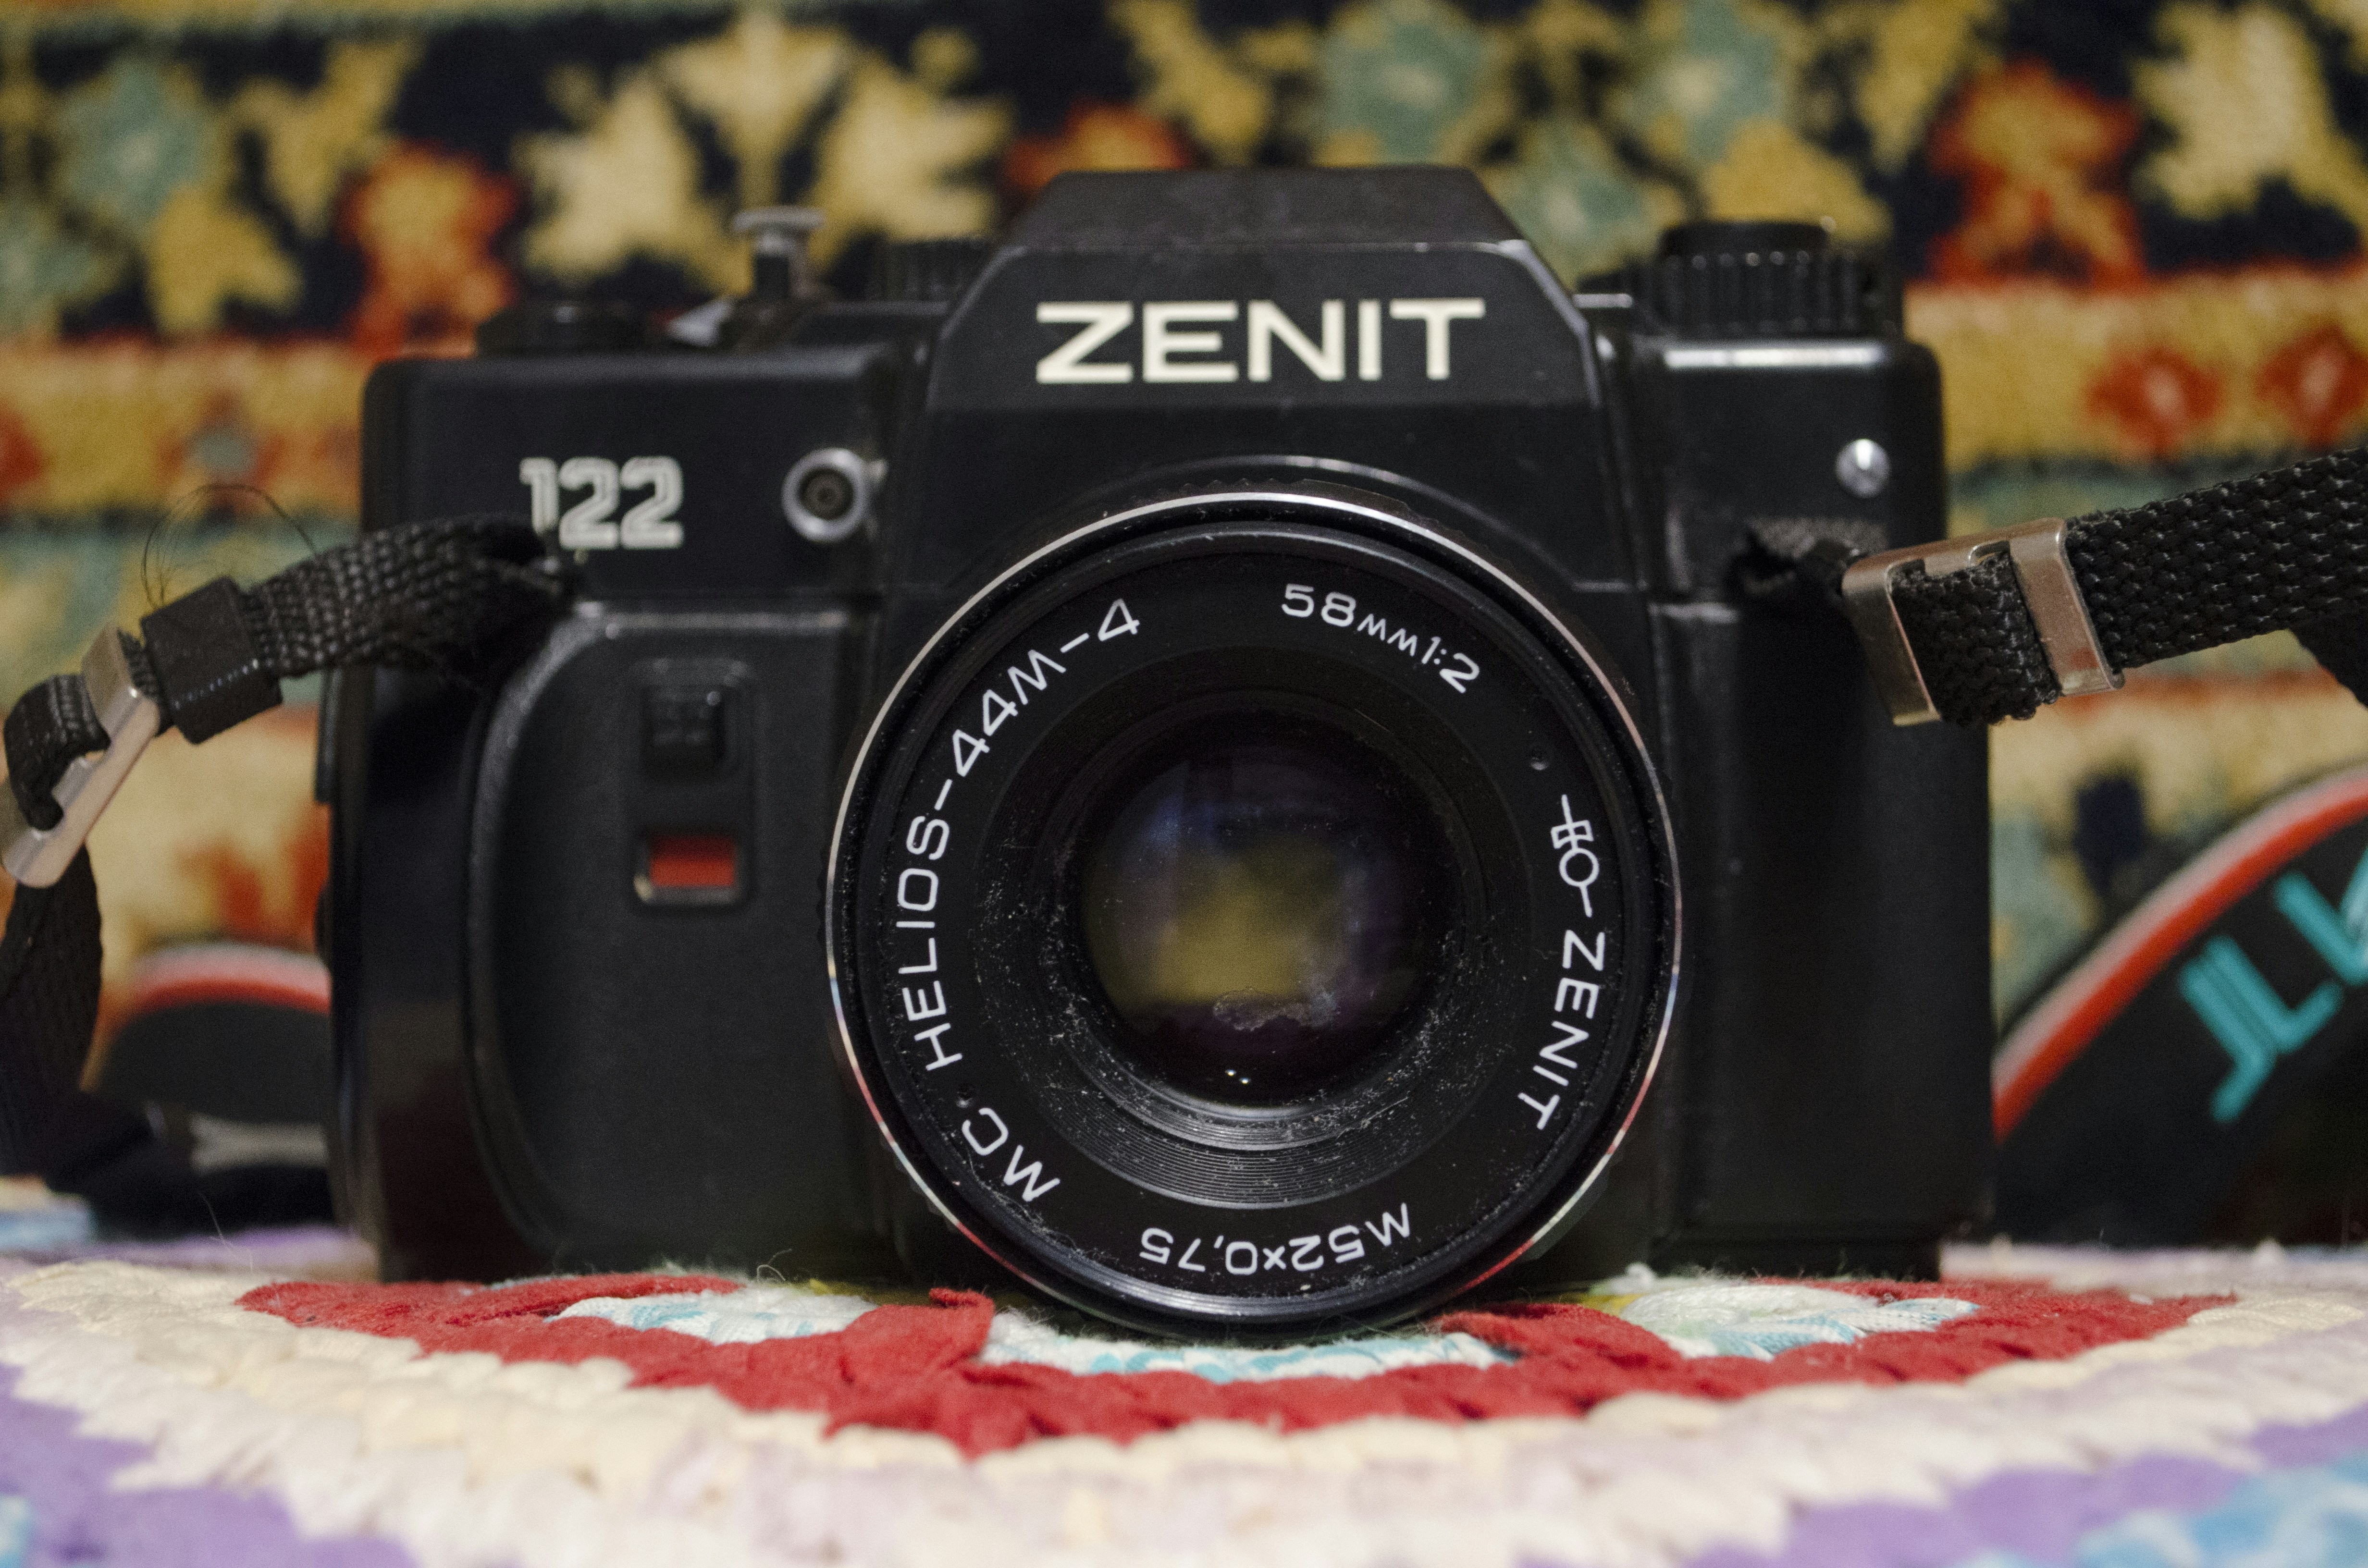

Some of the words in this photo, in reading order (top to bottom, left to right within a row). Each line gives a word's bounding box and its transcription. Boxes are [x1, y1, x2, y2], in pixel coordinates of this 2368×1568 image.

[1035, 296, 1487, 385] ZENIT
[519, 456, 684, 550] 122
[1517, 929, 1605, 1130] ZENIT
[961, 1107, 1061, 1202] MC
